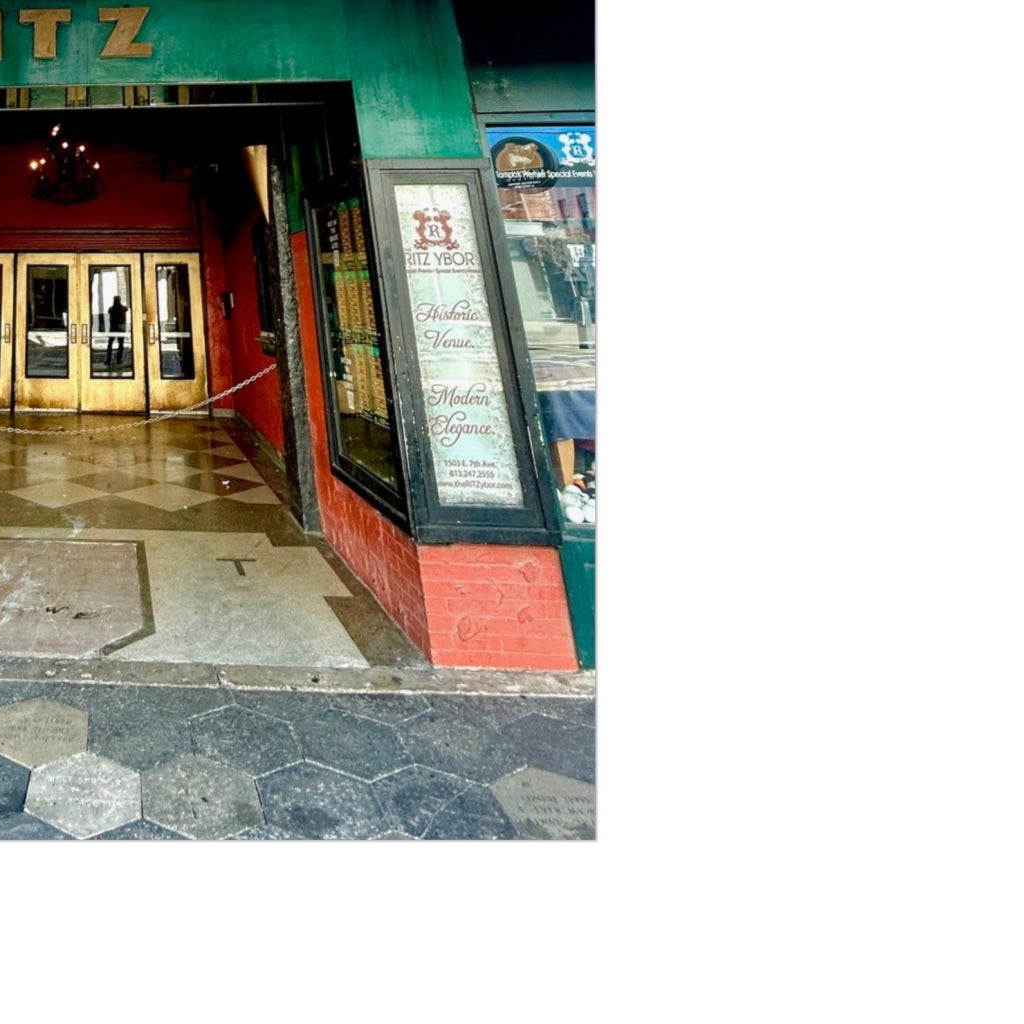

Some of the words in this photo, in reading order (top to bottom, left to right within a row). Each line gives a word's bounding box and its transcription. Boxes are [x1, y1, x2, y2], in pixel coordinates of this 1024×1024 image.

[548, 170, 571, 179] Special
[572, 170, 593, 178] Events
[404, 252, 431, 266] RITZ
[433, 252, 475, 266] YBOR
[416, 299, 479, 323] Historic
[424, 328, 475, 349] Venue.
[428, 382, 491, 407] Modern
[429, 410, 496, 447] Elegance.
[216, 557, 257, 576] T
